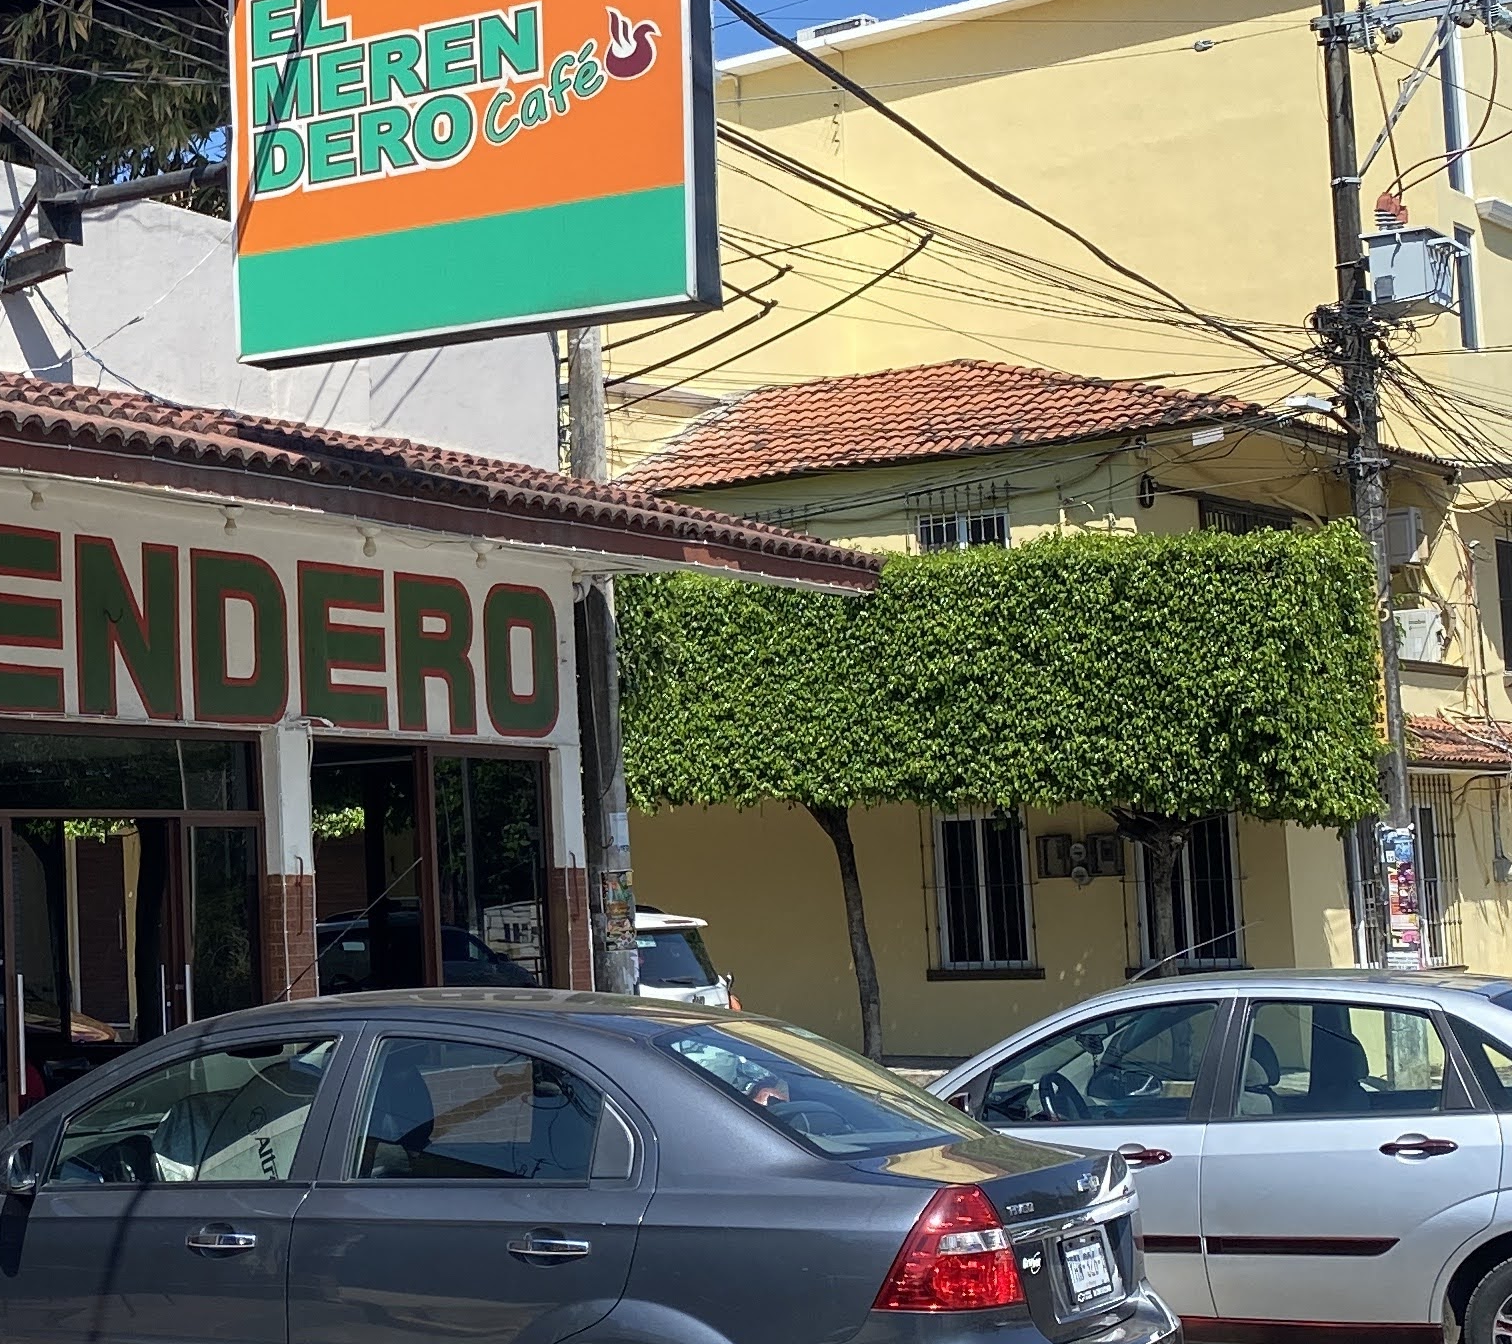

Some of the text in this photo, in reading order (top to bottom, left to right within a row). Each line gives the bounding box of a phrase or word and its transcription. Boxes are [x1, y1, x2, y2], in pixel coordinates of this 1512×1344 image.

[250, 5, 541, 129] MEREN
[485, 41, 605, 146] Café
[252, 94, 476, 197] DERO
